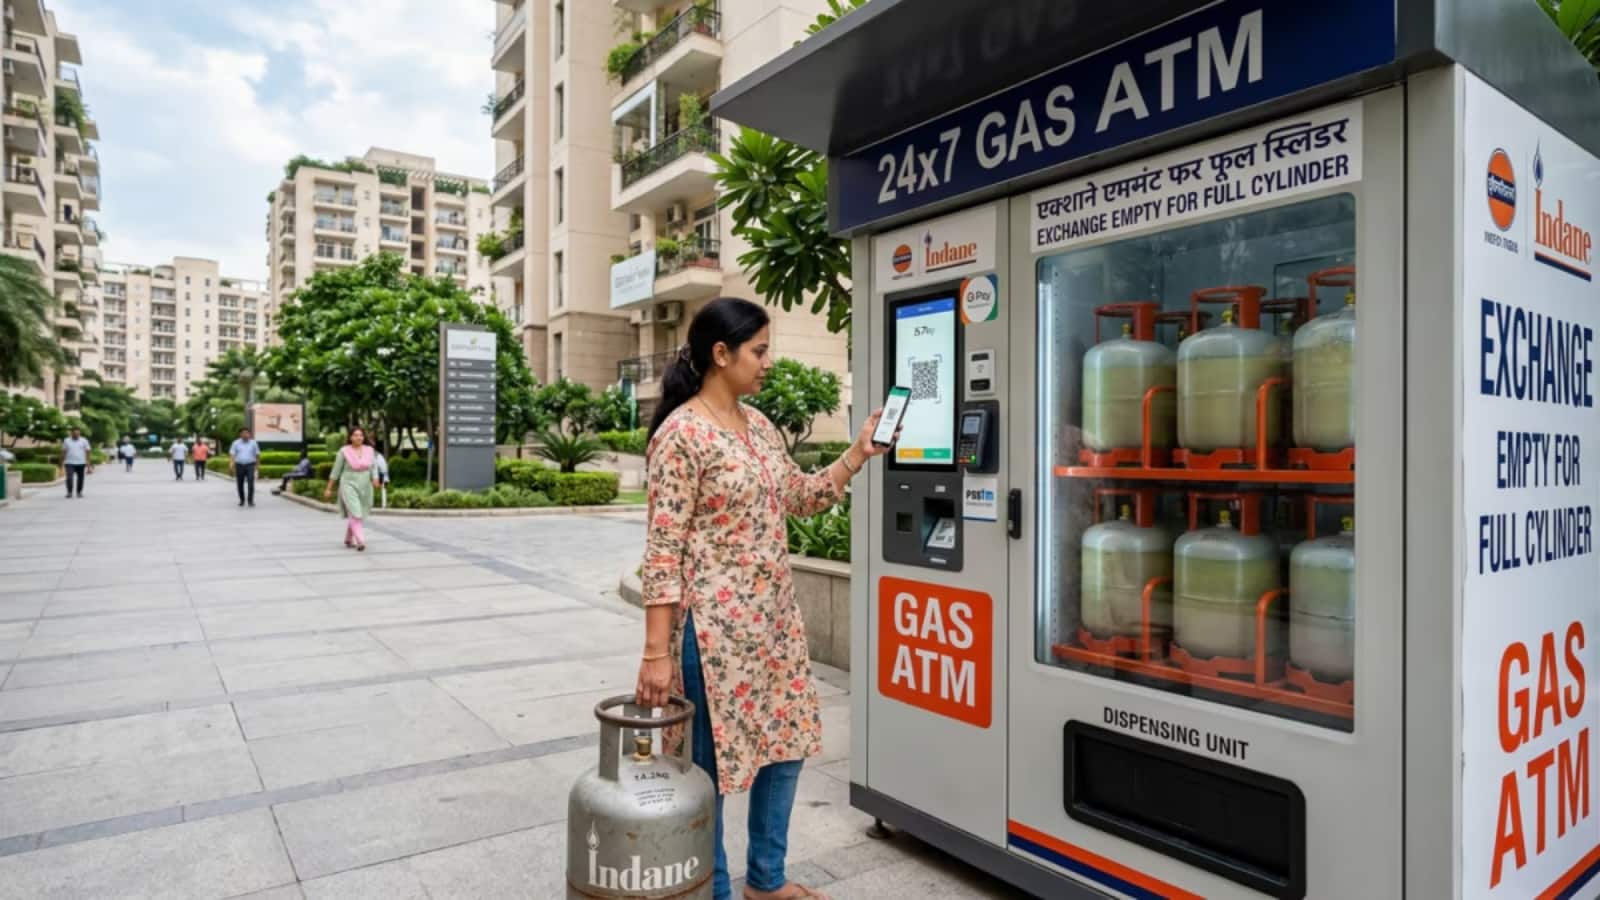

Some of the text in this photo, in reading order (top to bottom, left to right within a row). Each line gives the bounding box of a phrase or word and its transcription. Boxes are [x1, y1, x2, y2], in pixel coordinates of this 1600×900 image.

[877, 126, 961, 204] 24x7
[975, 85, 1076, 170] GAS
[1095, 9, 1264, 134] ATM
[1208, 142, 1258, 183] फूल
[1037, 153, 1349, 246] EXCHANGE EMPTY FOR FULL CYLINDER
[1535, 187, 1592, 265] Indane
[925, 241, 977, 267] Indane
[1480, 298, 1593, 408] EXCHANGE
[1496, 430, 1581, 489] EMPTY FOR
[1479, 505, 1592, 575] FULL CYLINDER
[893, 591, 974, 649] GAS
[890, 644, 976, 708] ATM
[1498, 620, 1586, 753] GAS
[1103, 706, 1249, 760] DISPENSING UNIT
[1489, 726, 1590, 890] ATM
[588, 848, 700, 891] Indane
